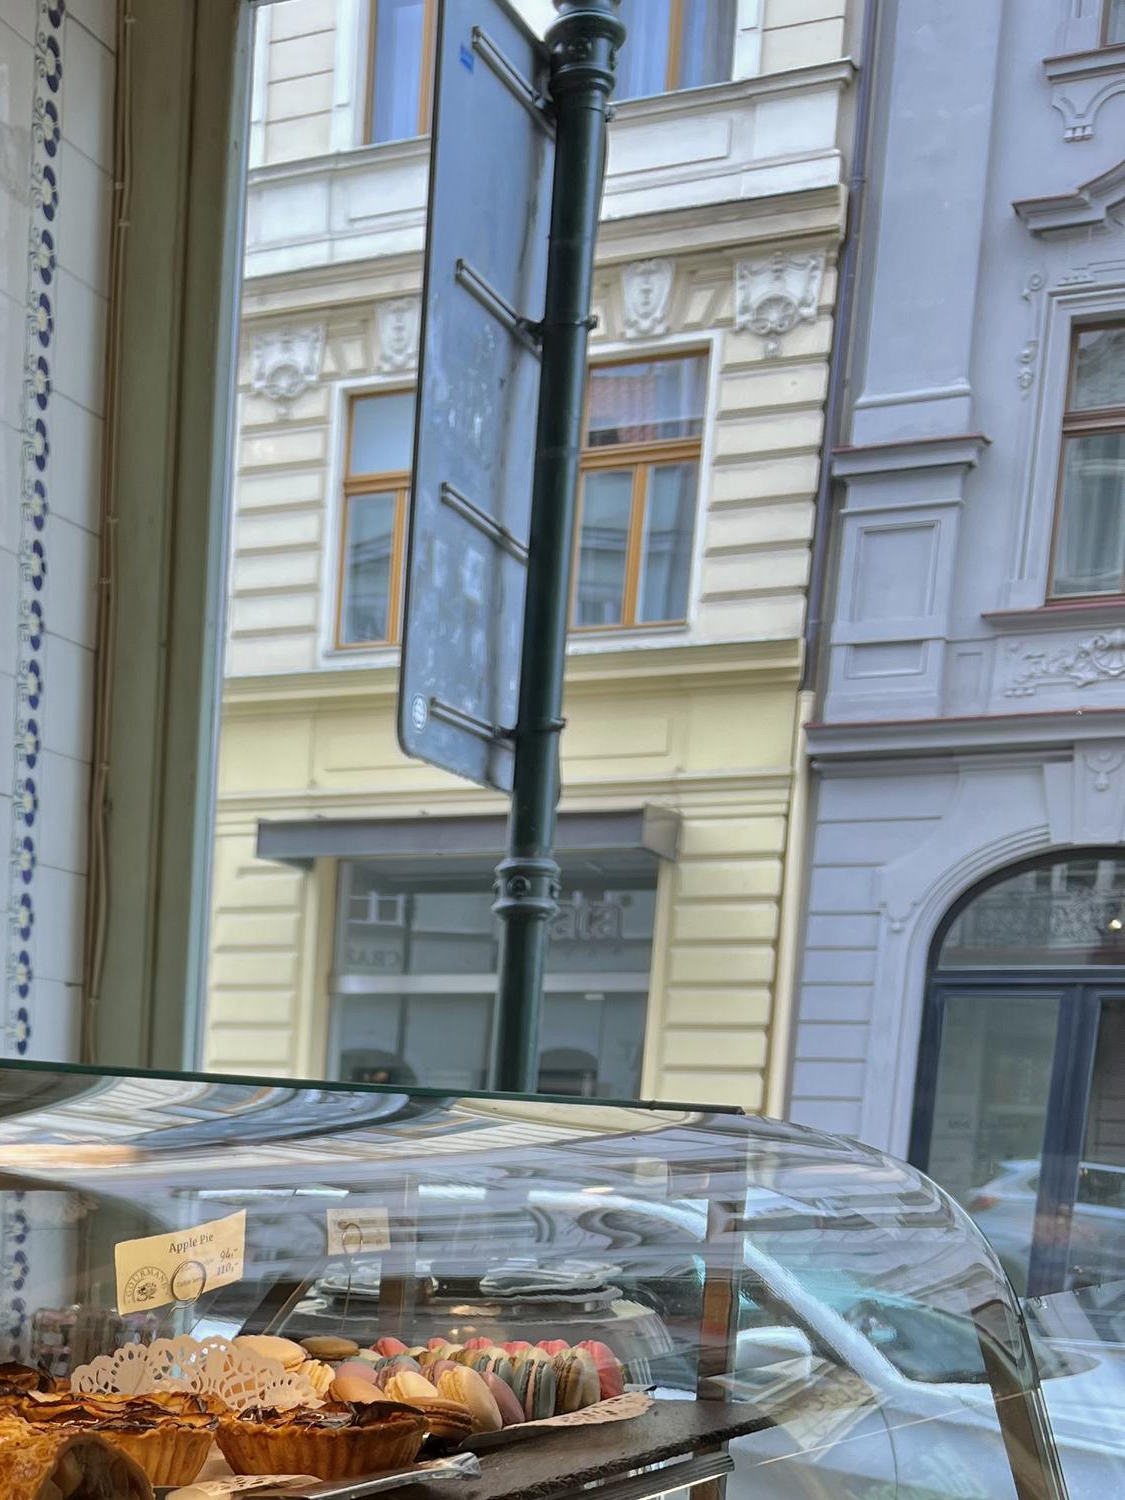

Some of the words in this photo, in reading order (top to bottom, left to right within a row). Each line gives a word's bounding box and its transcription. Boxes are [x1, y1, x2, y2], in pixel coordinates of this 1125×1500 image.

[168, 1237, 198, 1254] Apple
[199, 1232, 215, 1247] Pie
[219, 1247, 239, 1263] 94,-
